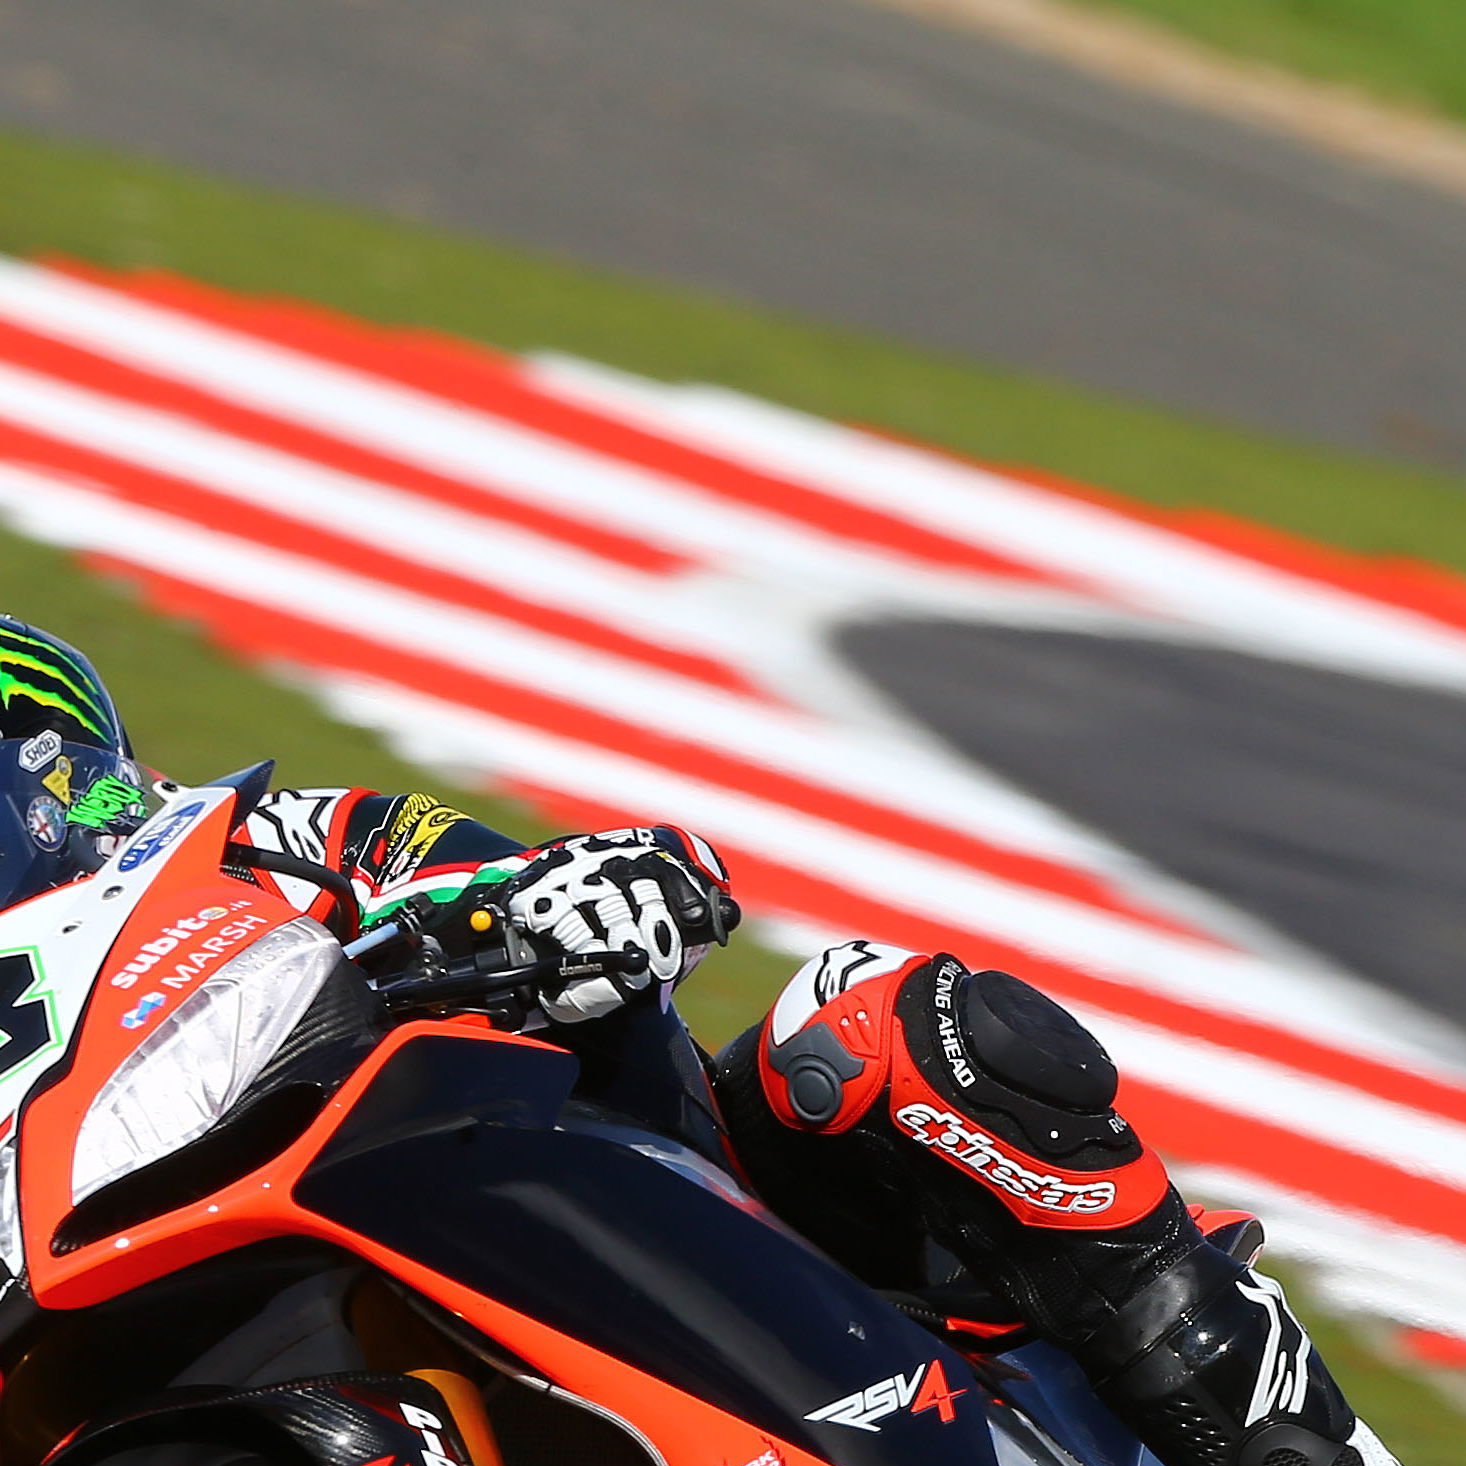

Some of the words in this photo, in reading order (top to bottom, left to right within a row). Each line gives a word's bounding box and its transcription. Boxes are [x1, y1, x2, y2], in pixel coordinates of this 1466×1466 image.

[160, 914, 269, 989] MARSH
[935, 960, 963, 1009] RACING
[936, 1012, 976, 1089] AHEAD
[802, 1359, 969, 1432] RSV4
